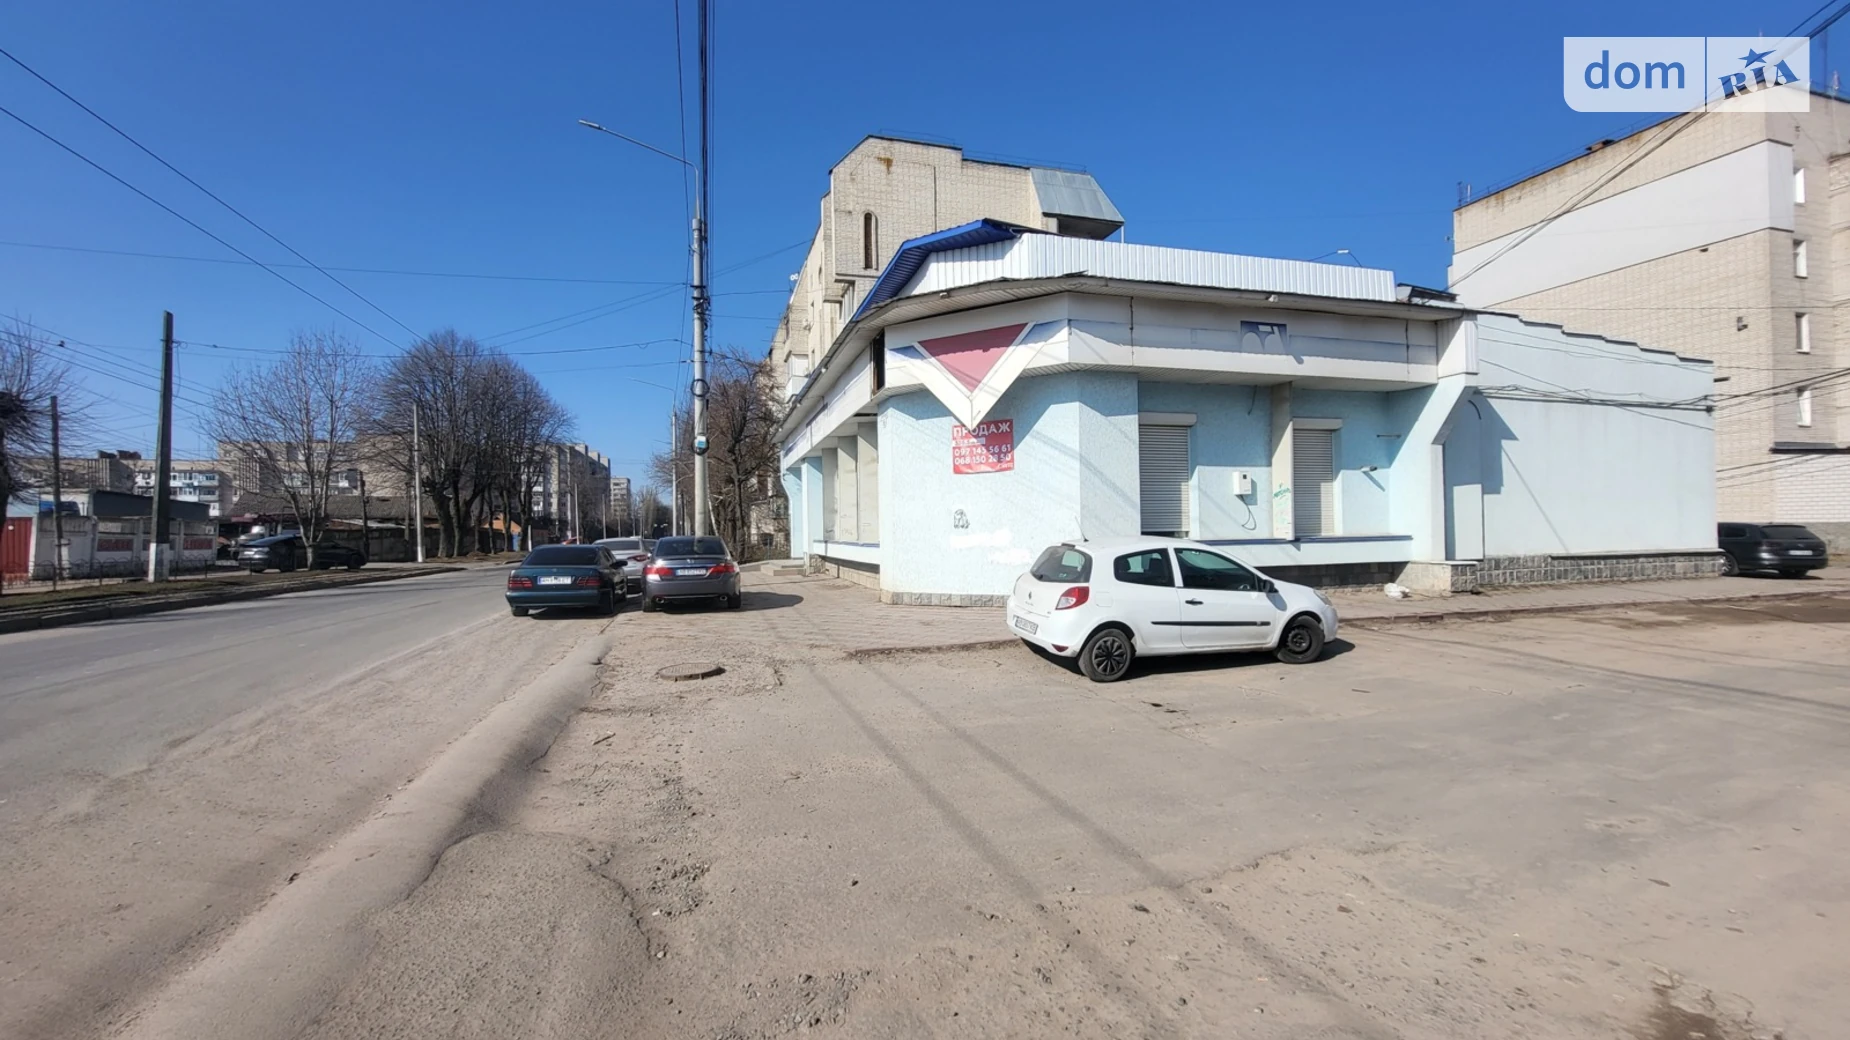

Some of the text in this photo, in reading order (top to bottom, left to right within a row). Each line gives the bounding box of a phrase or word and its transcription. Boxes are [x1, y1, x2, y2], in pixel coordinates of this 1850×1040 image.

[954, 448, 970, 456] 097
[989, 445, 999, 453] 56
[1001, 444, 1011, 452] 61
